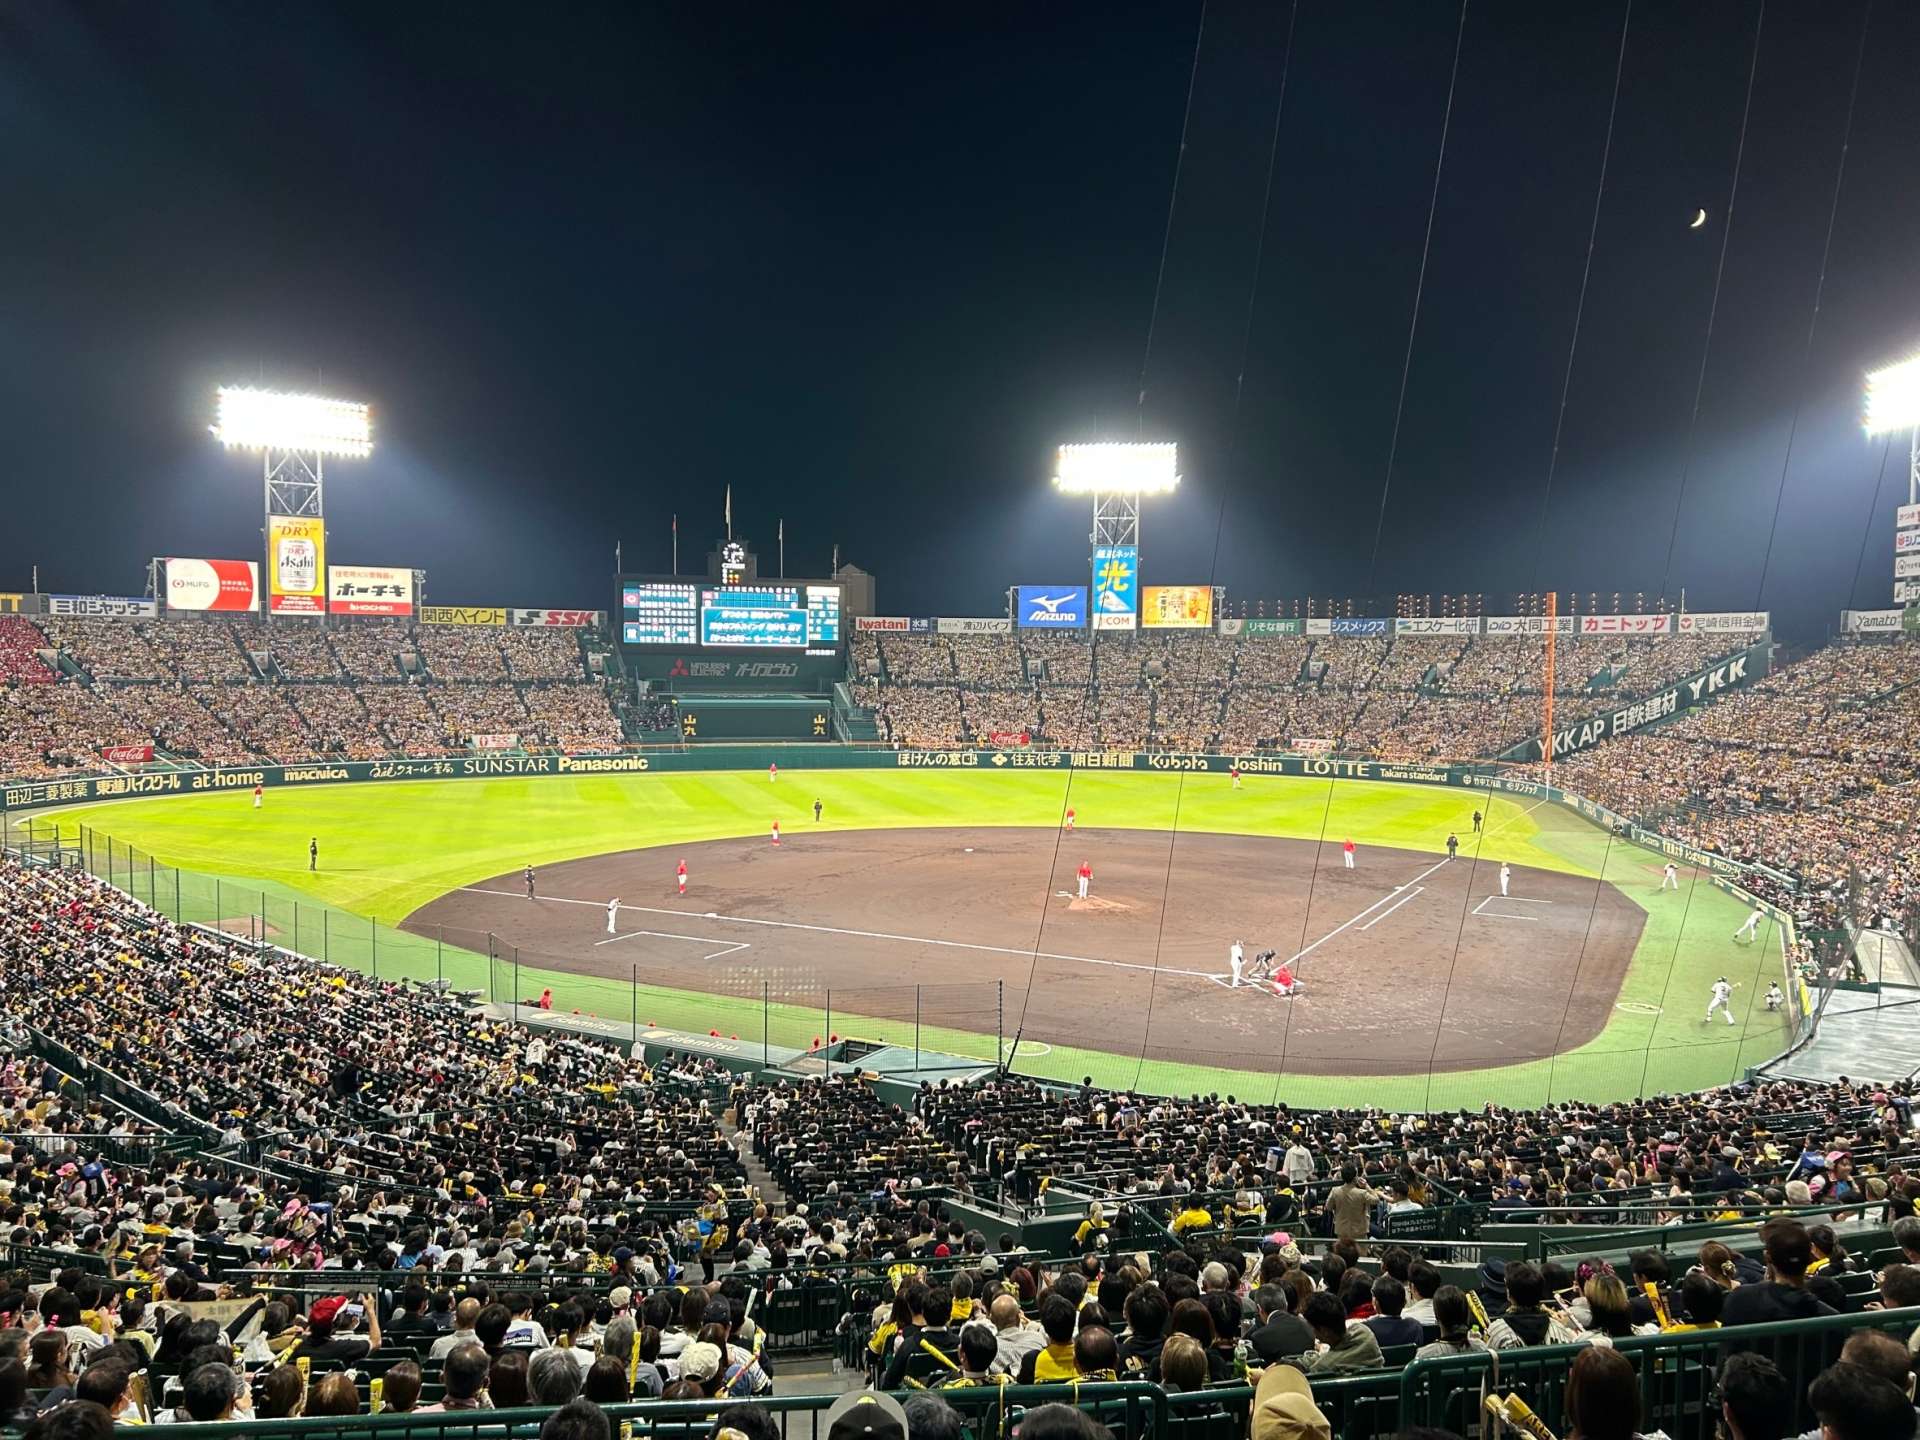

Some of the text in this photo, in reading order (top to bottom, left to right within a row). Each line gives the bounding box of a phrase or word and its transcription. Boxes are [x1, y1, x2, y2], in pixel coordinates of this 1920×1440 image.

[280, 555, 314, 568] Asahi
[1096, 560, 1134, 592] 光
[336, 582, 406, 597] ホーチキ
[56, 600, 149, 616] 三和シャッター
[421, 608, 506, 624] 関西ペイント
[544, 611, 595, 626] SSK
[1584, 616, 1668, 631] カニトップ
[1694, 615, 1766, 629] 尼崎信用金庫
[1856, 615, 1897, 627] Yamato
[858, 618, 907, 630] Iwatani
[1249, 622, 1296, 632] りそな銀行
[1332, 621, 1386, 632] シスメックス
[1412, 619, 1478, 633] エスケー化研
[1513, 618, 1573, 633] 大同工業
[1688, 656, 1747, 701] YKK
[1612, 688, 1678, 736] 日鉄建材
[684, 714, 697, 736] 山九
[814, 714, 826, 735] 山九
[463, 758, 550, 774] SUNSTAR
[558, 755, 649, 772] Panasonic
[898, 752, 973, 766] ほけんの窓口
[1011, 752, 1062, 767] 住友化学
[1071, 752, 1134, 768] 朝日新聞
[1149, 755, 1208, 770] Kubota
[1229, 757, 1283, 772] Joshin
[1303, 760, 1370, 777] LOTTE
[1380, 767, 1408, 779] Takara
[1408, 770, 1448, 782] standard
[96, 774, 181, 796] 東進ハイスクール
[192, 767, 265, 789] at home
[6, 781, 88, 806] 田辺三菱製薬
[557, 1015, 620, 1032] idemitsu
[667, 1033, 740, 1052] idemitsu
